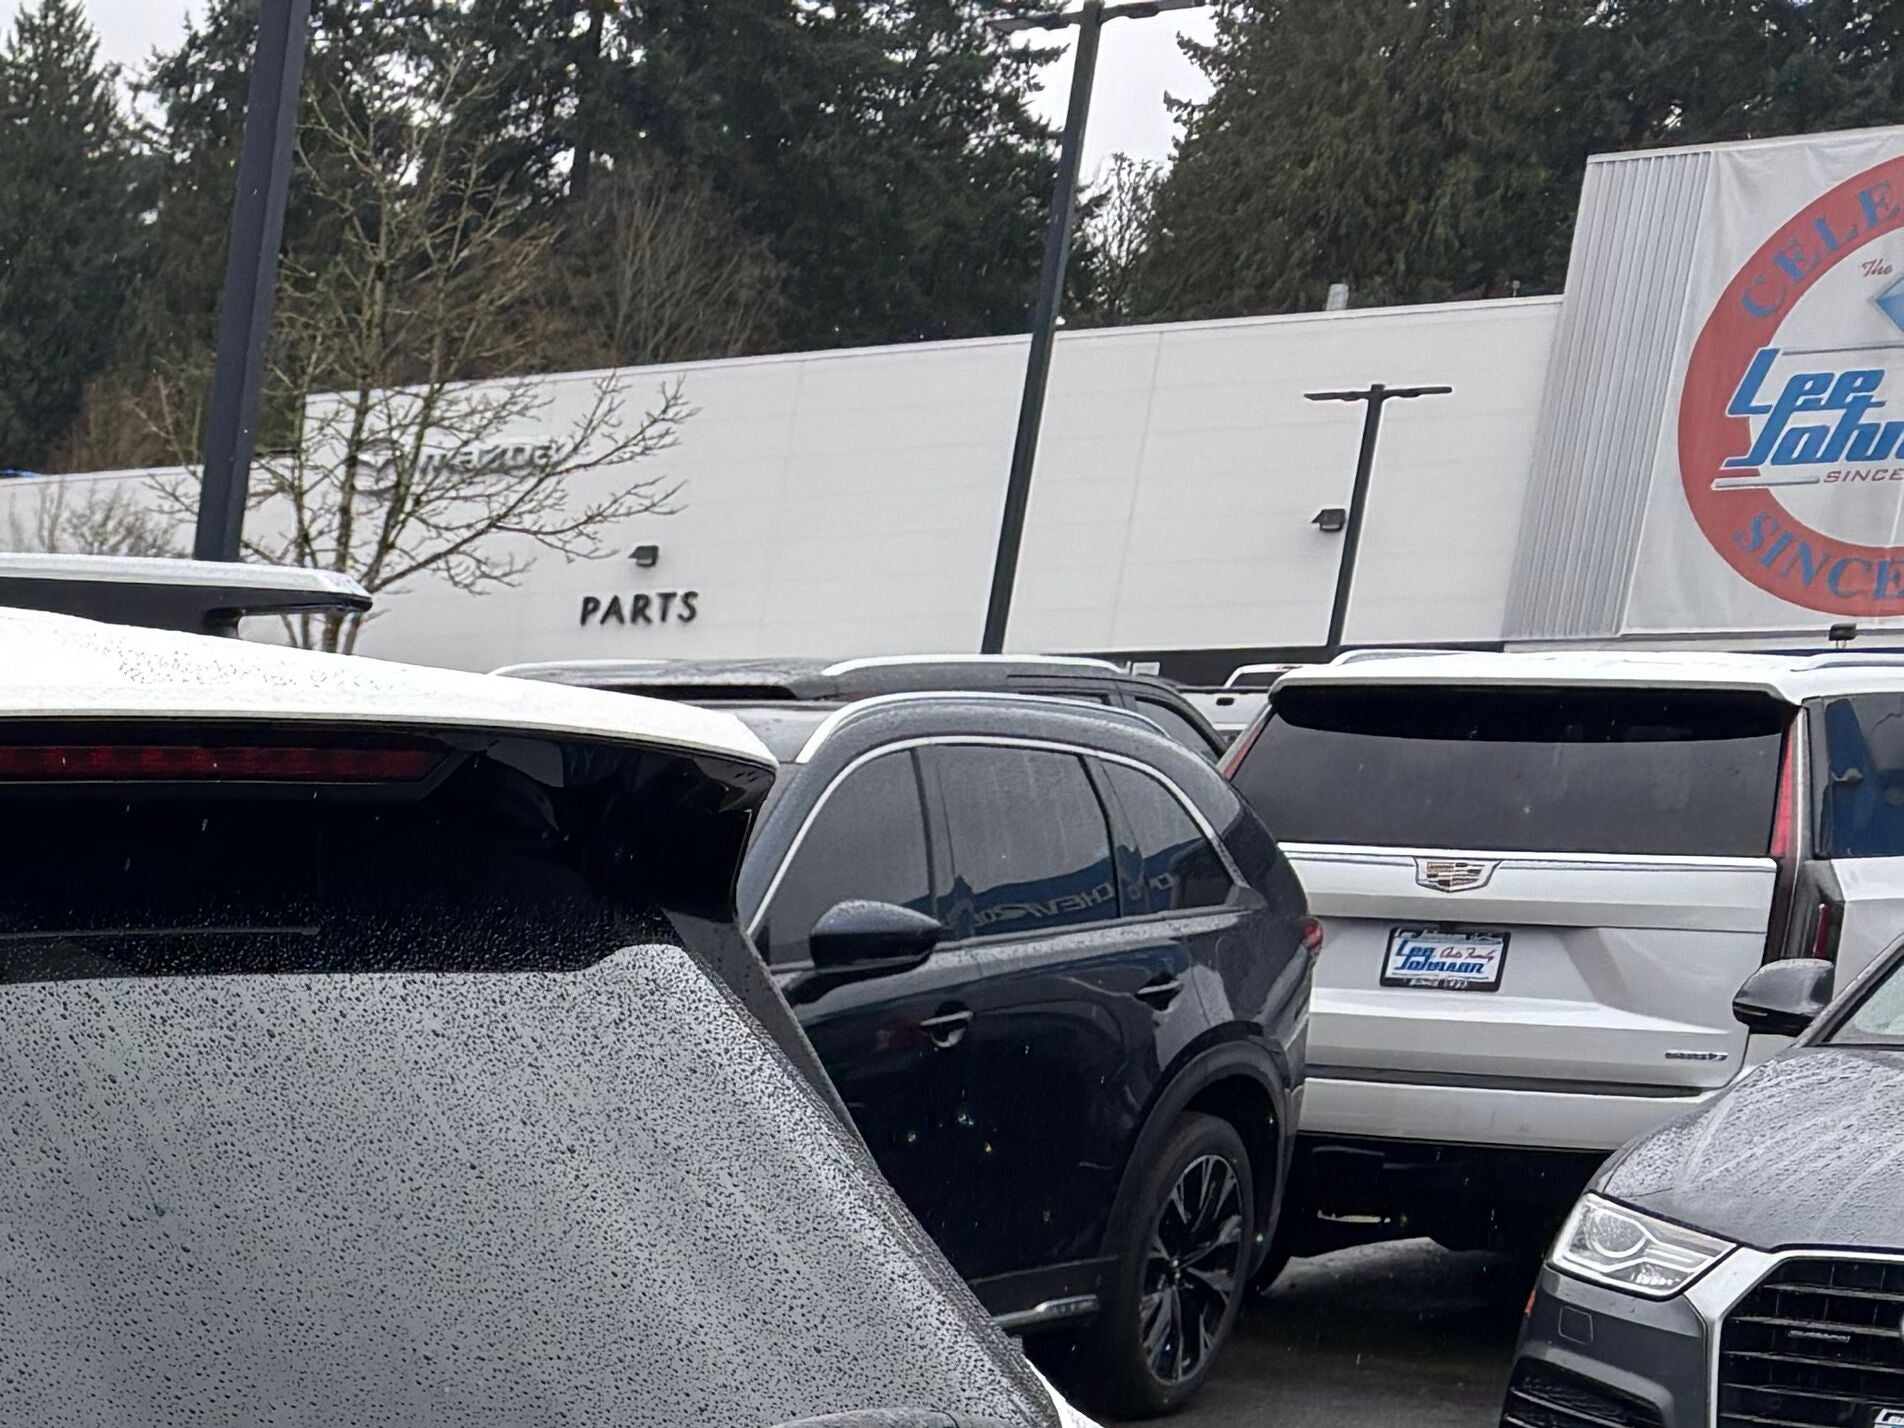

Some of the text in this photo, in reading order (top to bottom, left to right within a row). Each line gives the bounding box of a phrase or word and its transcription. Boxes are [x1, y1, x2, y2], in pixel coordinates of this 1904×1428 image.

[1862, 258, 1893, 277] The
[1726, 348, 1885, 414] Lee
[580, 591, 699, 627] PARTS
